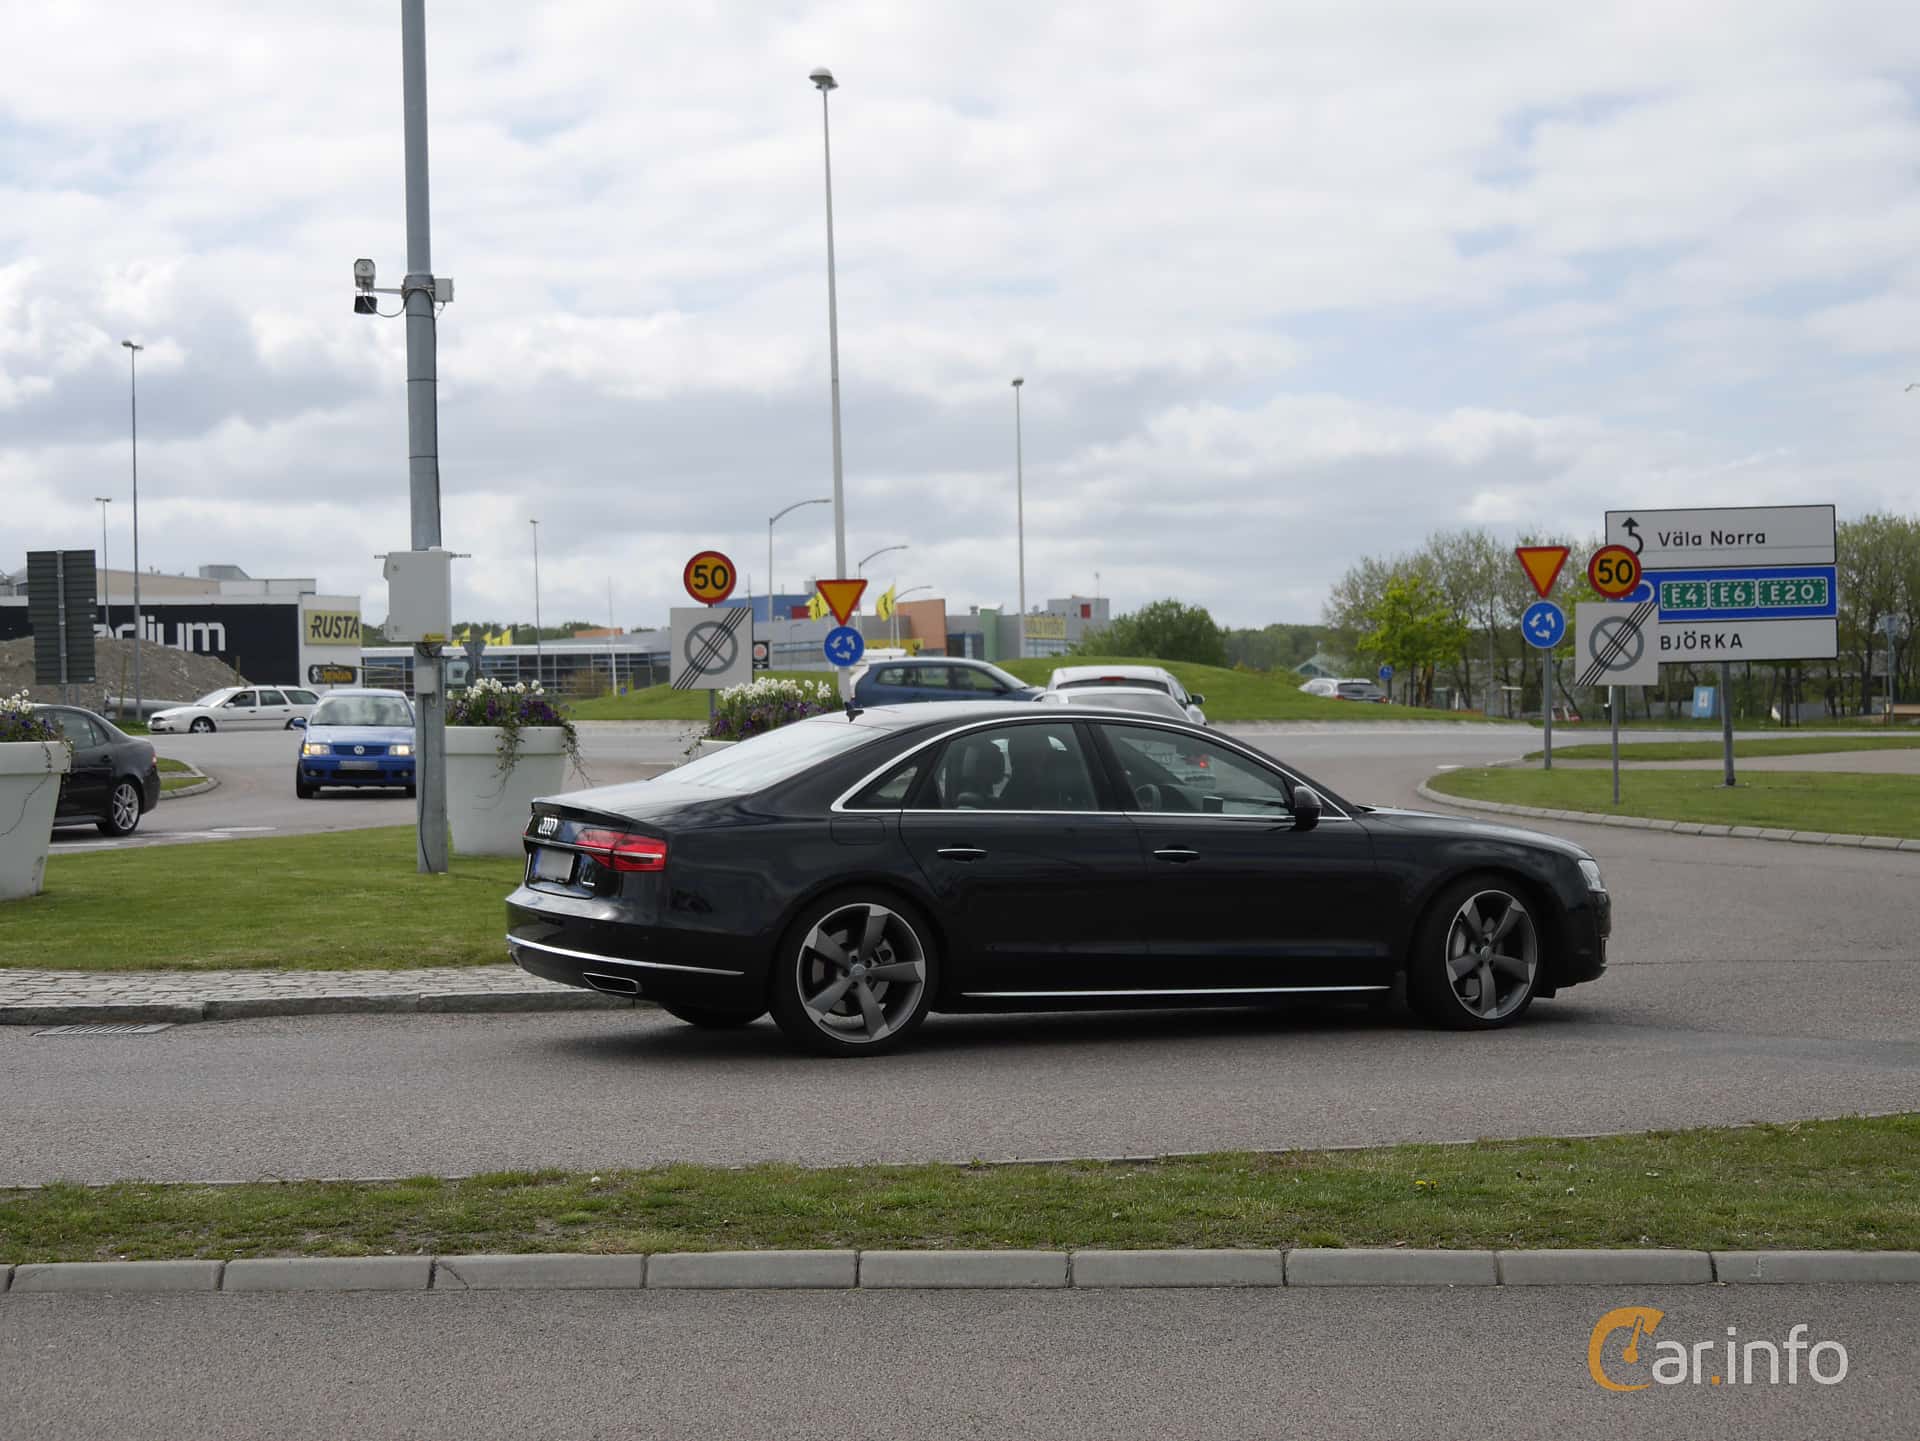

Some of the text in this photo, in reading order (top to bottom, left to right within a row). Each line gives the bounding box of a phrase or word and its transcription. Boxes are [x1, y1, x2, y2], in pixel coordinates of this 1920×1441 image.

[1658, 530, 1766, 547] Väla Norra
[694, 565, 729, 590] 50
[1598, 559, 1633, 584] 50
[1672, 585, 1815, 603] E4 E6 E20
[311, 616, 360, 639] RUSTA
[1660, 631, 1744, 650] BJÖRKA
